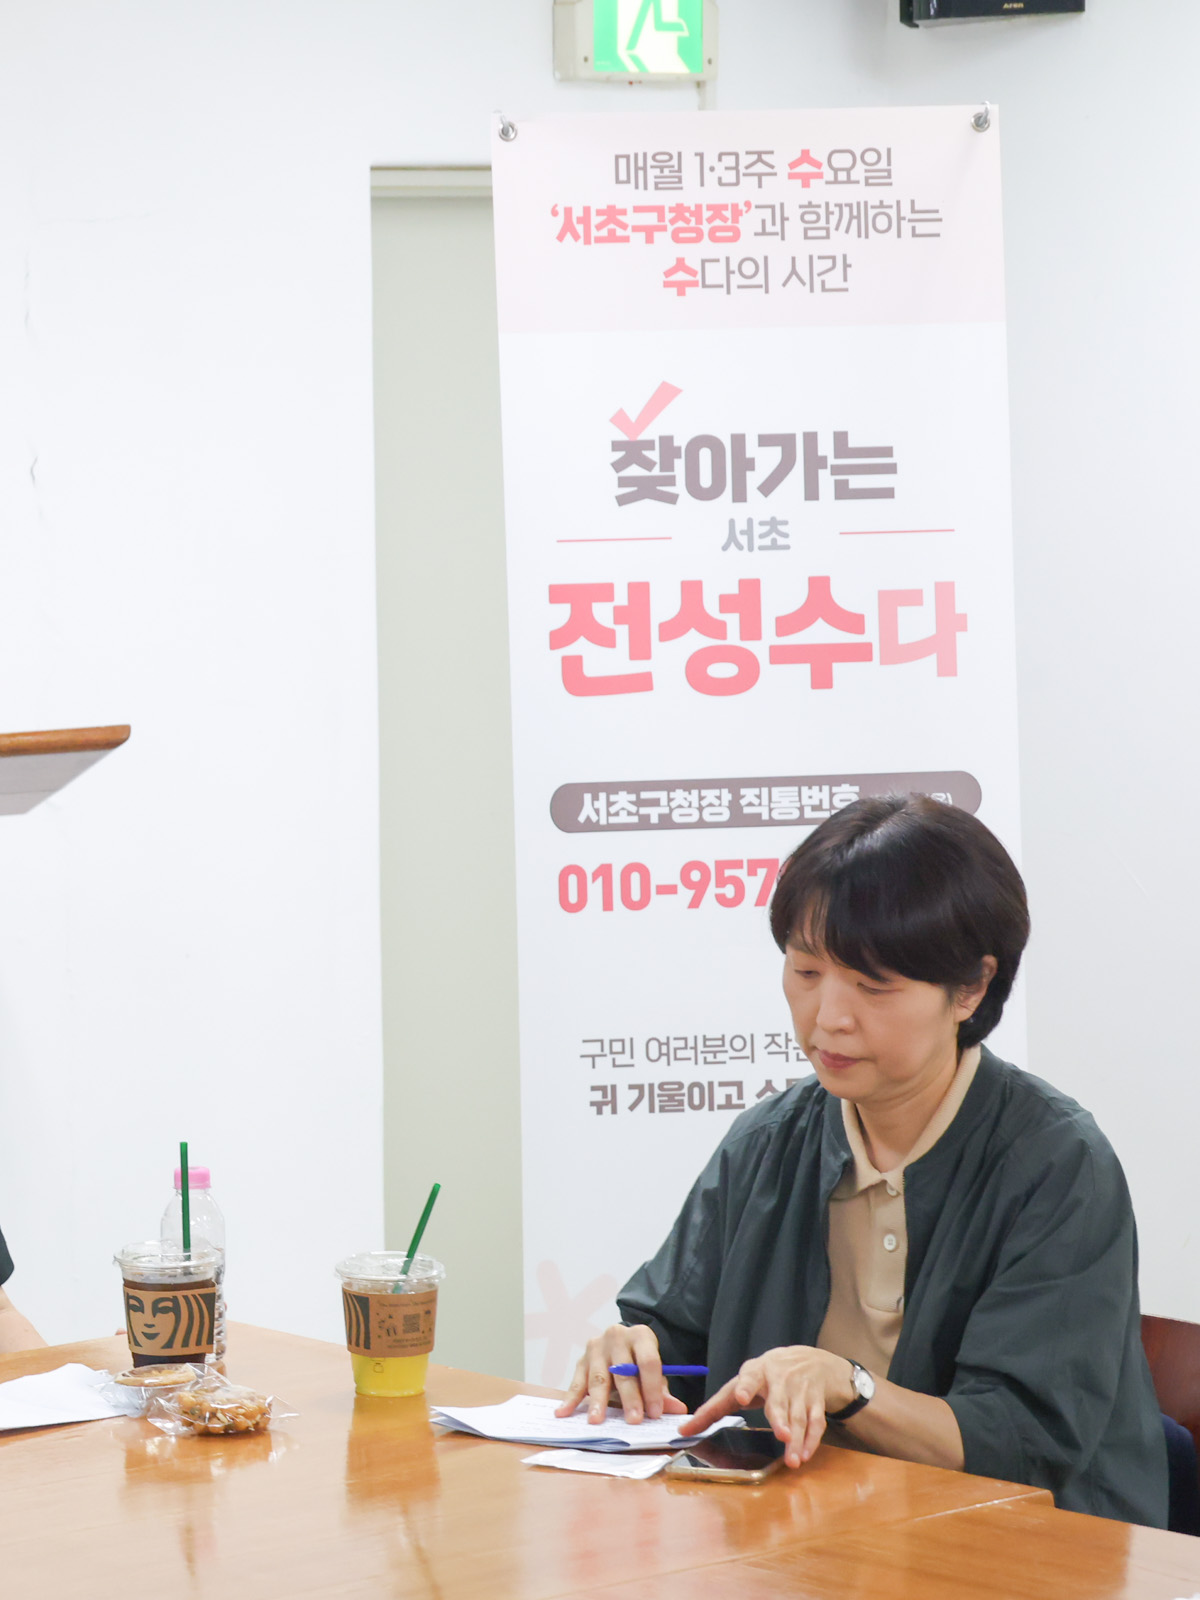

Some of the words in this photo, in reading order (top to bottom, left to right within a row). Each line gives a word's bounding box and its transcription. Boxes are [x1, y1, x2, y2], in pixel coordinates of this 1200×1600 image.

[614, 151, 684, 191] 매월
[787, 147, 894, 189] 수요일
[798, 199, 943, 241] 함께하는
[662, 255, 770, 297] 수다의
[781, 253, 853, 294] 시간
[610, 430, 898, 507] 찾아가는
[721, 516, 791, 553] 서초
[547, 575, 968, 698] 전성수다
[577, 789, 733, 826] 서초구청장
[738, 783, 860, 821] 직통번호
[557, 857, 780, 914] 010-957
[579, 1036, 636, 1070] 구민
[644, 1032, 756, 1067] 여러분의
[589, 1083, 618, 1116] 귀
[626, 1079, 746, 1115] 기울이고
